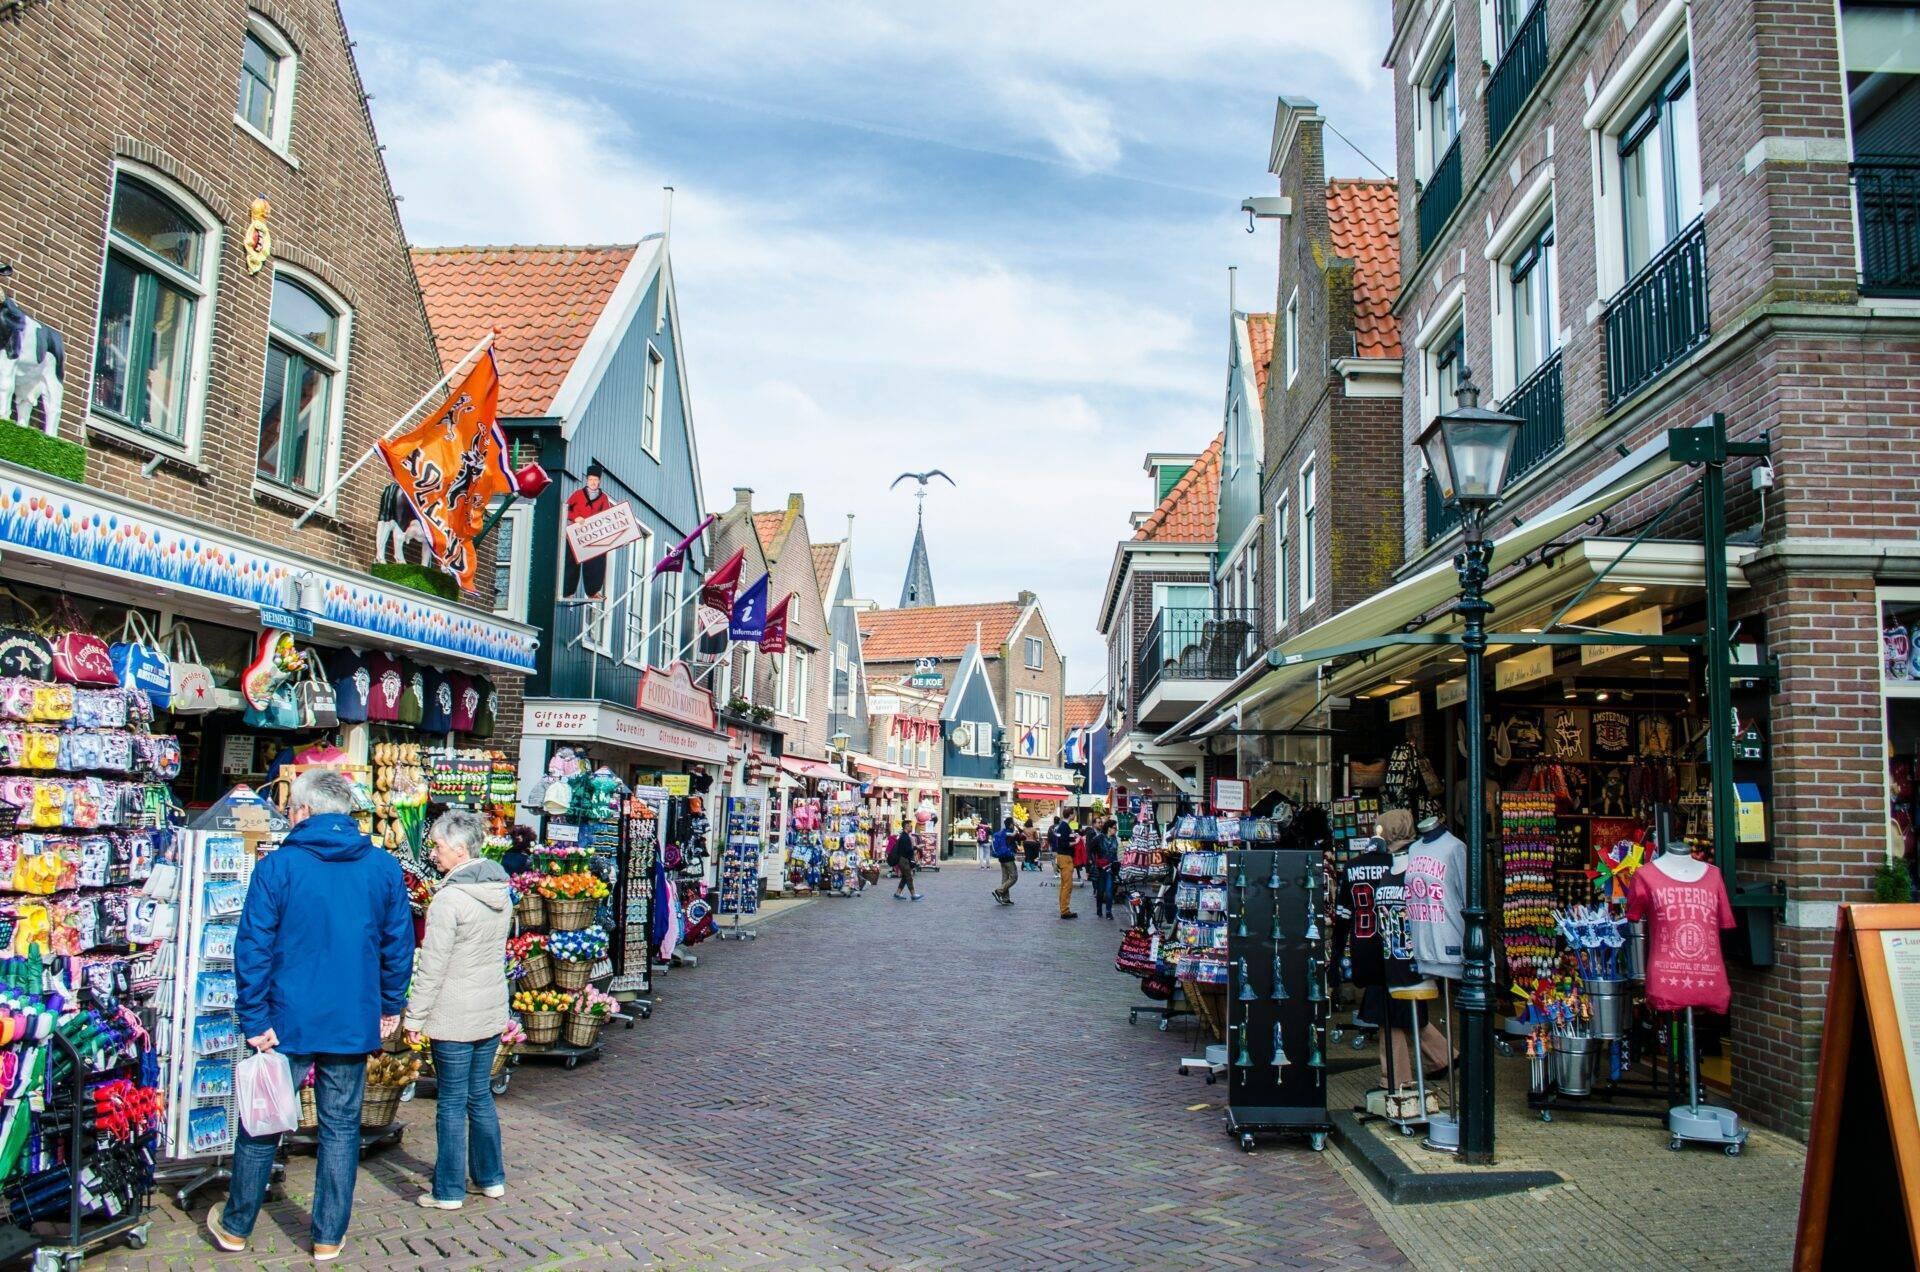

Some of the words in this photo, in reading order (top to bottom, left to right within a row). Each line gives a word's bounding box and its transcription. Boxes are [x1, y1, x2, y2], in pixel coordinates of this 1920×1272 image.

[574, 515, 612, 537] FOTO'S
[612, 508, 626, 520] IN
[577, 518, 630, 545] KOSTUUM
[732, 628, 763, 637] Informatie
[0, 635, 52, 665] msterdam
[912, 678, 924, 686] DE
[925, 678, 943, 686] KOE
[534, 711, 587, 721] Giftshop
[1592, 711, 1630, 726] AMSTERDAM
[536, 720, 551, 728] de
[556, 720, 584, 729] Boer
[616, 718, 646, 738] Souvenirs
[1025, 769, 1038, 778] Fish
[1045, 771, 1063, 781] Chips
[1429, 884, 1443, 899] 75
[1351, 882, 1377, 938] 8
[1666, 903, 1711, 923] CITY
